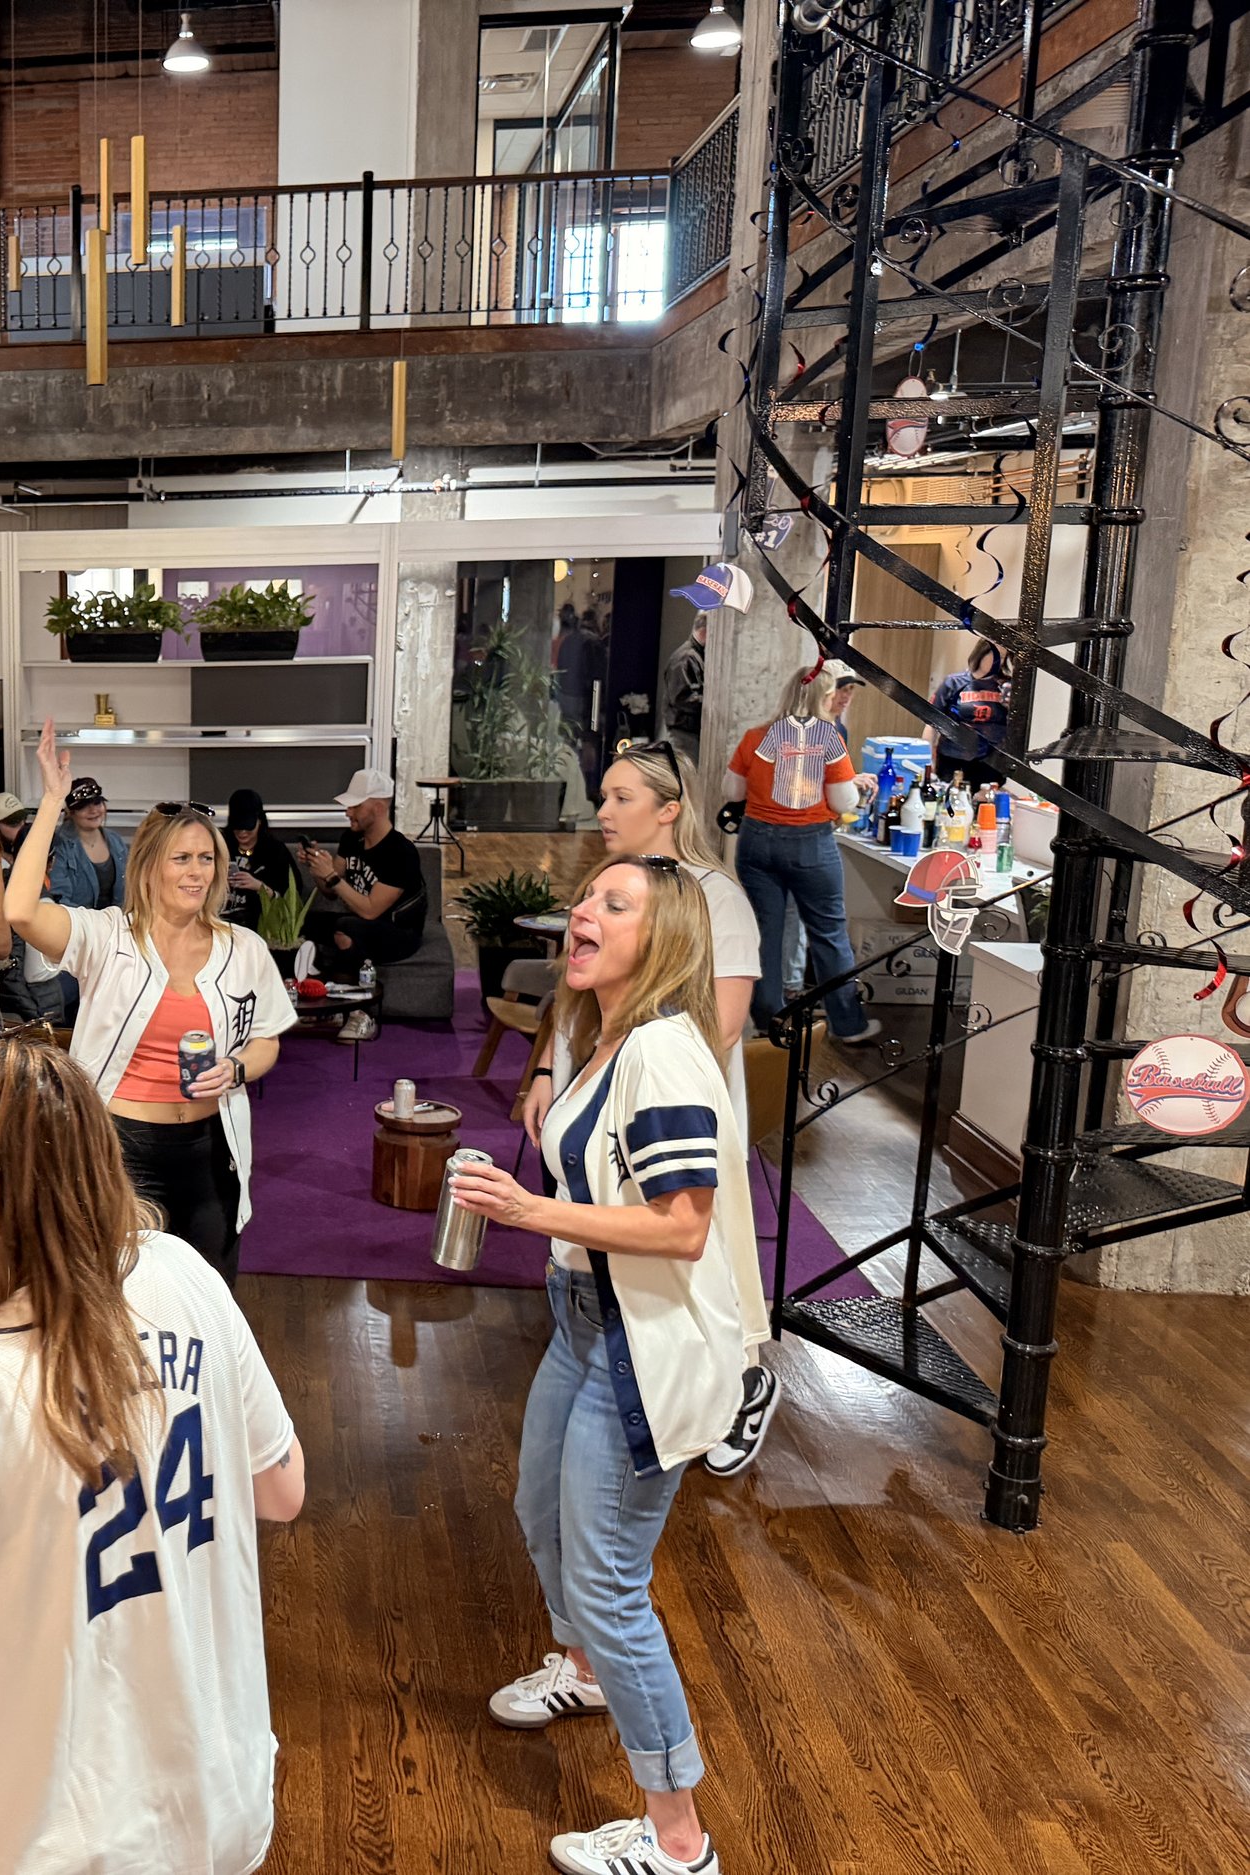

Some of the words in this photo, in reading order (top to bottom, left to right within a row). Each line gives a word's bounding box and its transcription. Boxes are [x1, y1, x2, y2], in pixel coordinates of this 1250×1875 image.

[225, 989, 257, 1056] D
[1127, 1064, 1245, 1097] Baseball
[78, 1402, 214, 1624] 24
